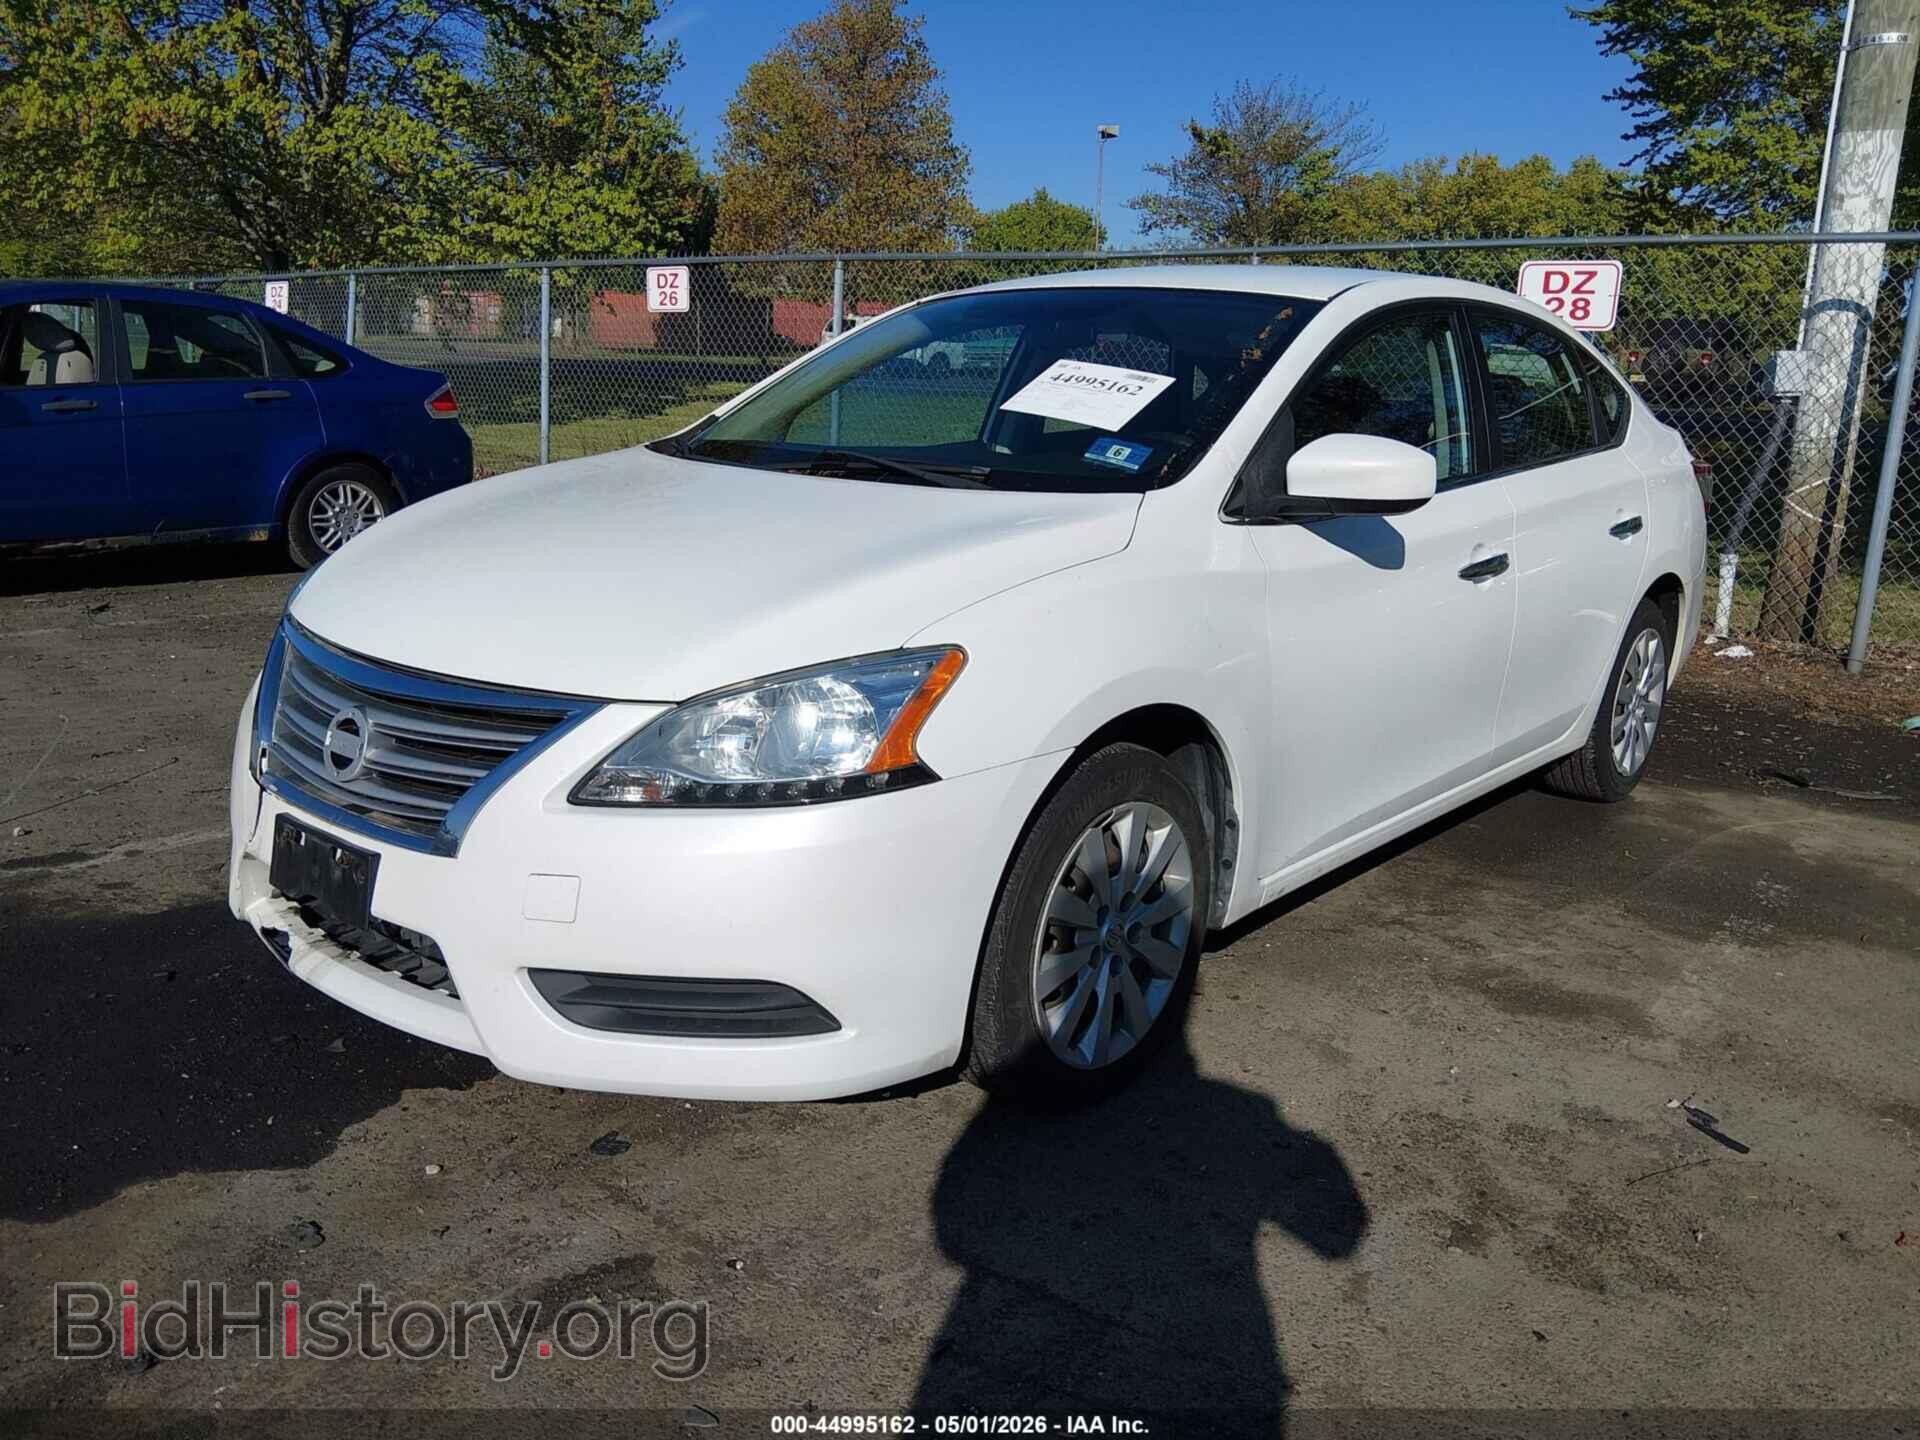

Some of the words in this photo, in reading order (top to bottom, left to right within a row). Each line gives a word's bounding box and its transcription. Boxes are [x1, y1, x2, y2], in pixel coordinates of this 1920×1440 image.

[657, 273, 679, 289] DZ
[1543, 271, 1598, 295] DZ
[271, 286, 284, 298] DZ
[659, 291, 678, 306] 26
[1545, 297, 1591, 321] 28
[1050, 372, 1143, 396] 44995162
[1113, 447, 1125, 458] 6
